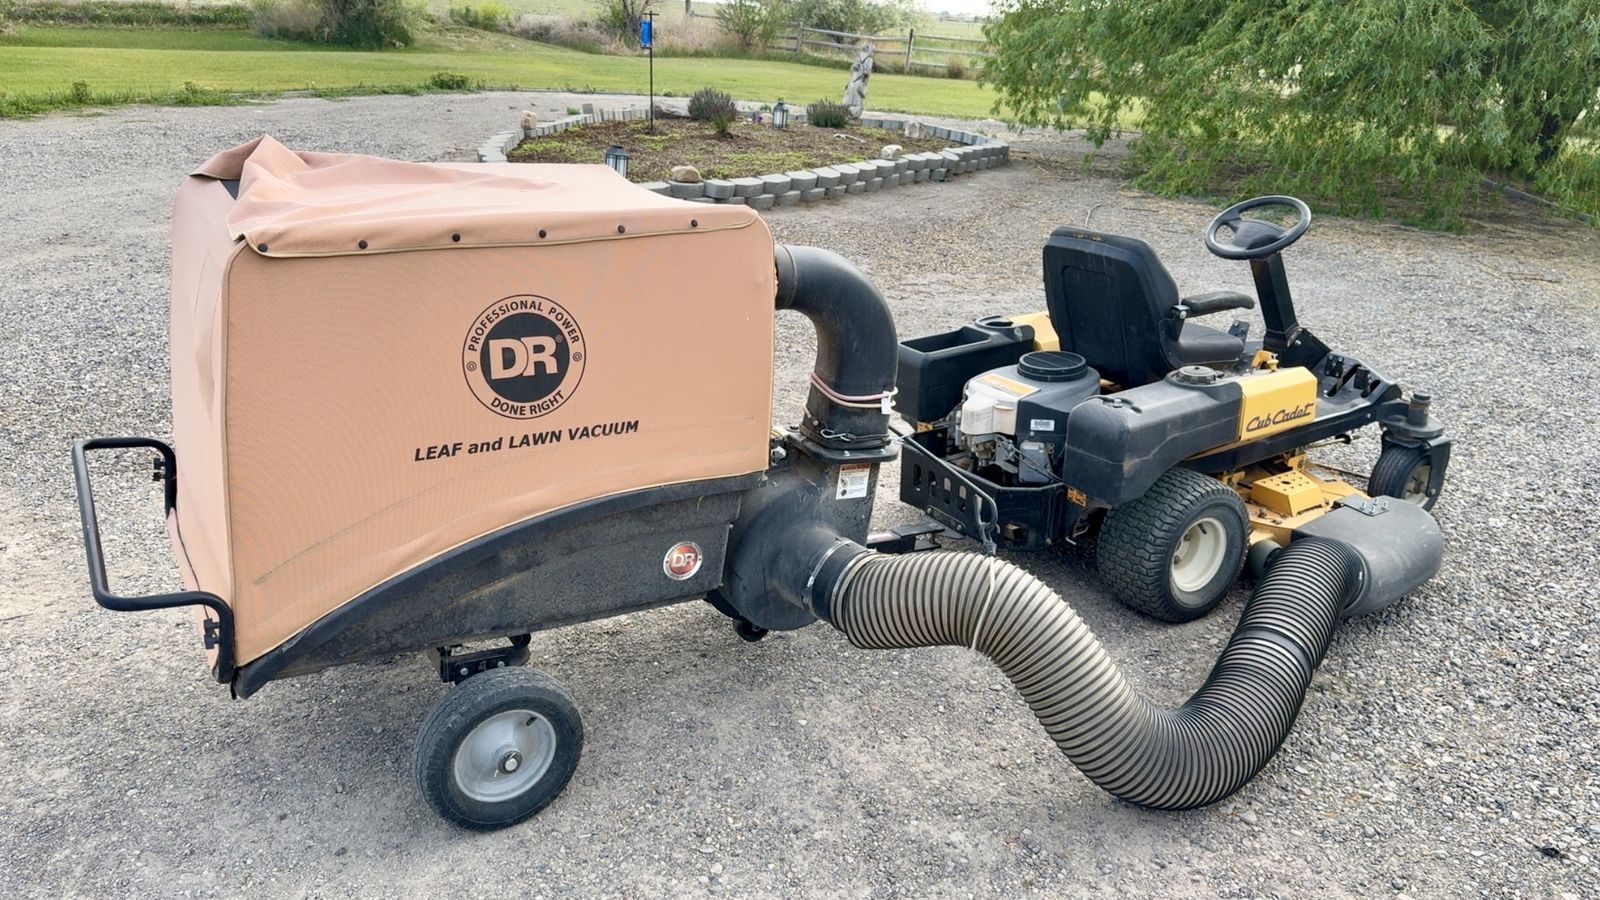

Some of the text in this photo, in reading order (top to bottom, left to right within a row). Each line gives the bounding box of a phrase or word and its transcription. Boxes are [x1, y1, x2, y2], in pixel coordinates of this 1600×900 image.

[468, 300, 579, 352] PROFESSIONAL POWER
[488, 335, 558, 380] DR
[491, 390, 564, 416] DONE RIGHT
[1246, 403, 1314, 432] Cub Cadet
[414, 420, 639, 461] LEAF and LAWN VACUUM
[671, 553, 696, 567] DR
